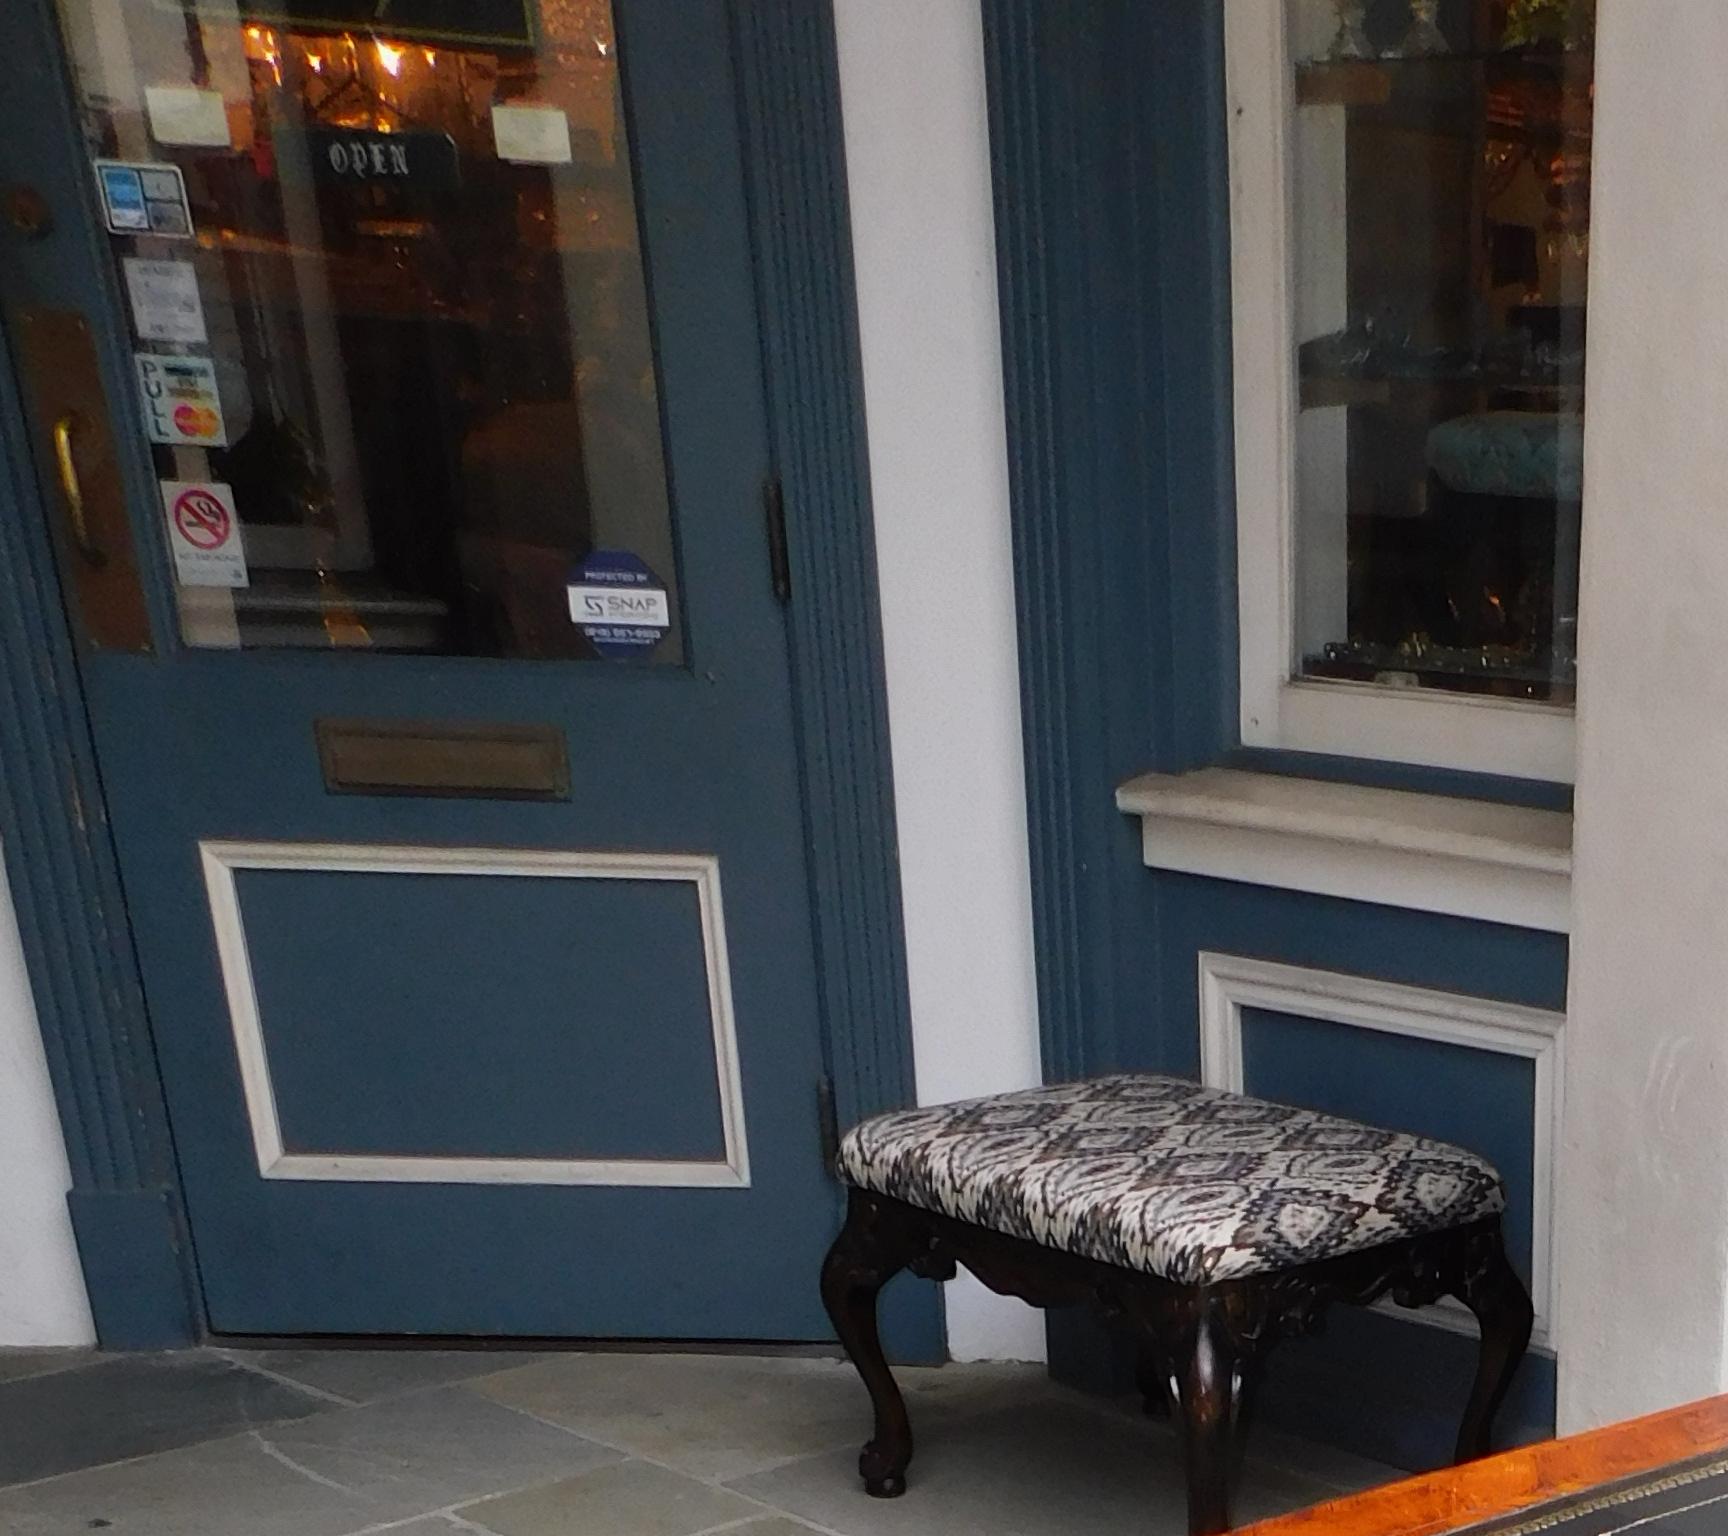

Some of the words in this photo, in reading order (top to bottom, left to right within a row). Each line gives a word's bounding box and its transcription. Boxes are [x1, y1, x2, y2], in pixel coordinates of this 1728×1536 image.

[328, 141, 409, 178] OPEN
[143, 361, 170, 437] PULL
[607, 596, 658, 611] SNAP
